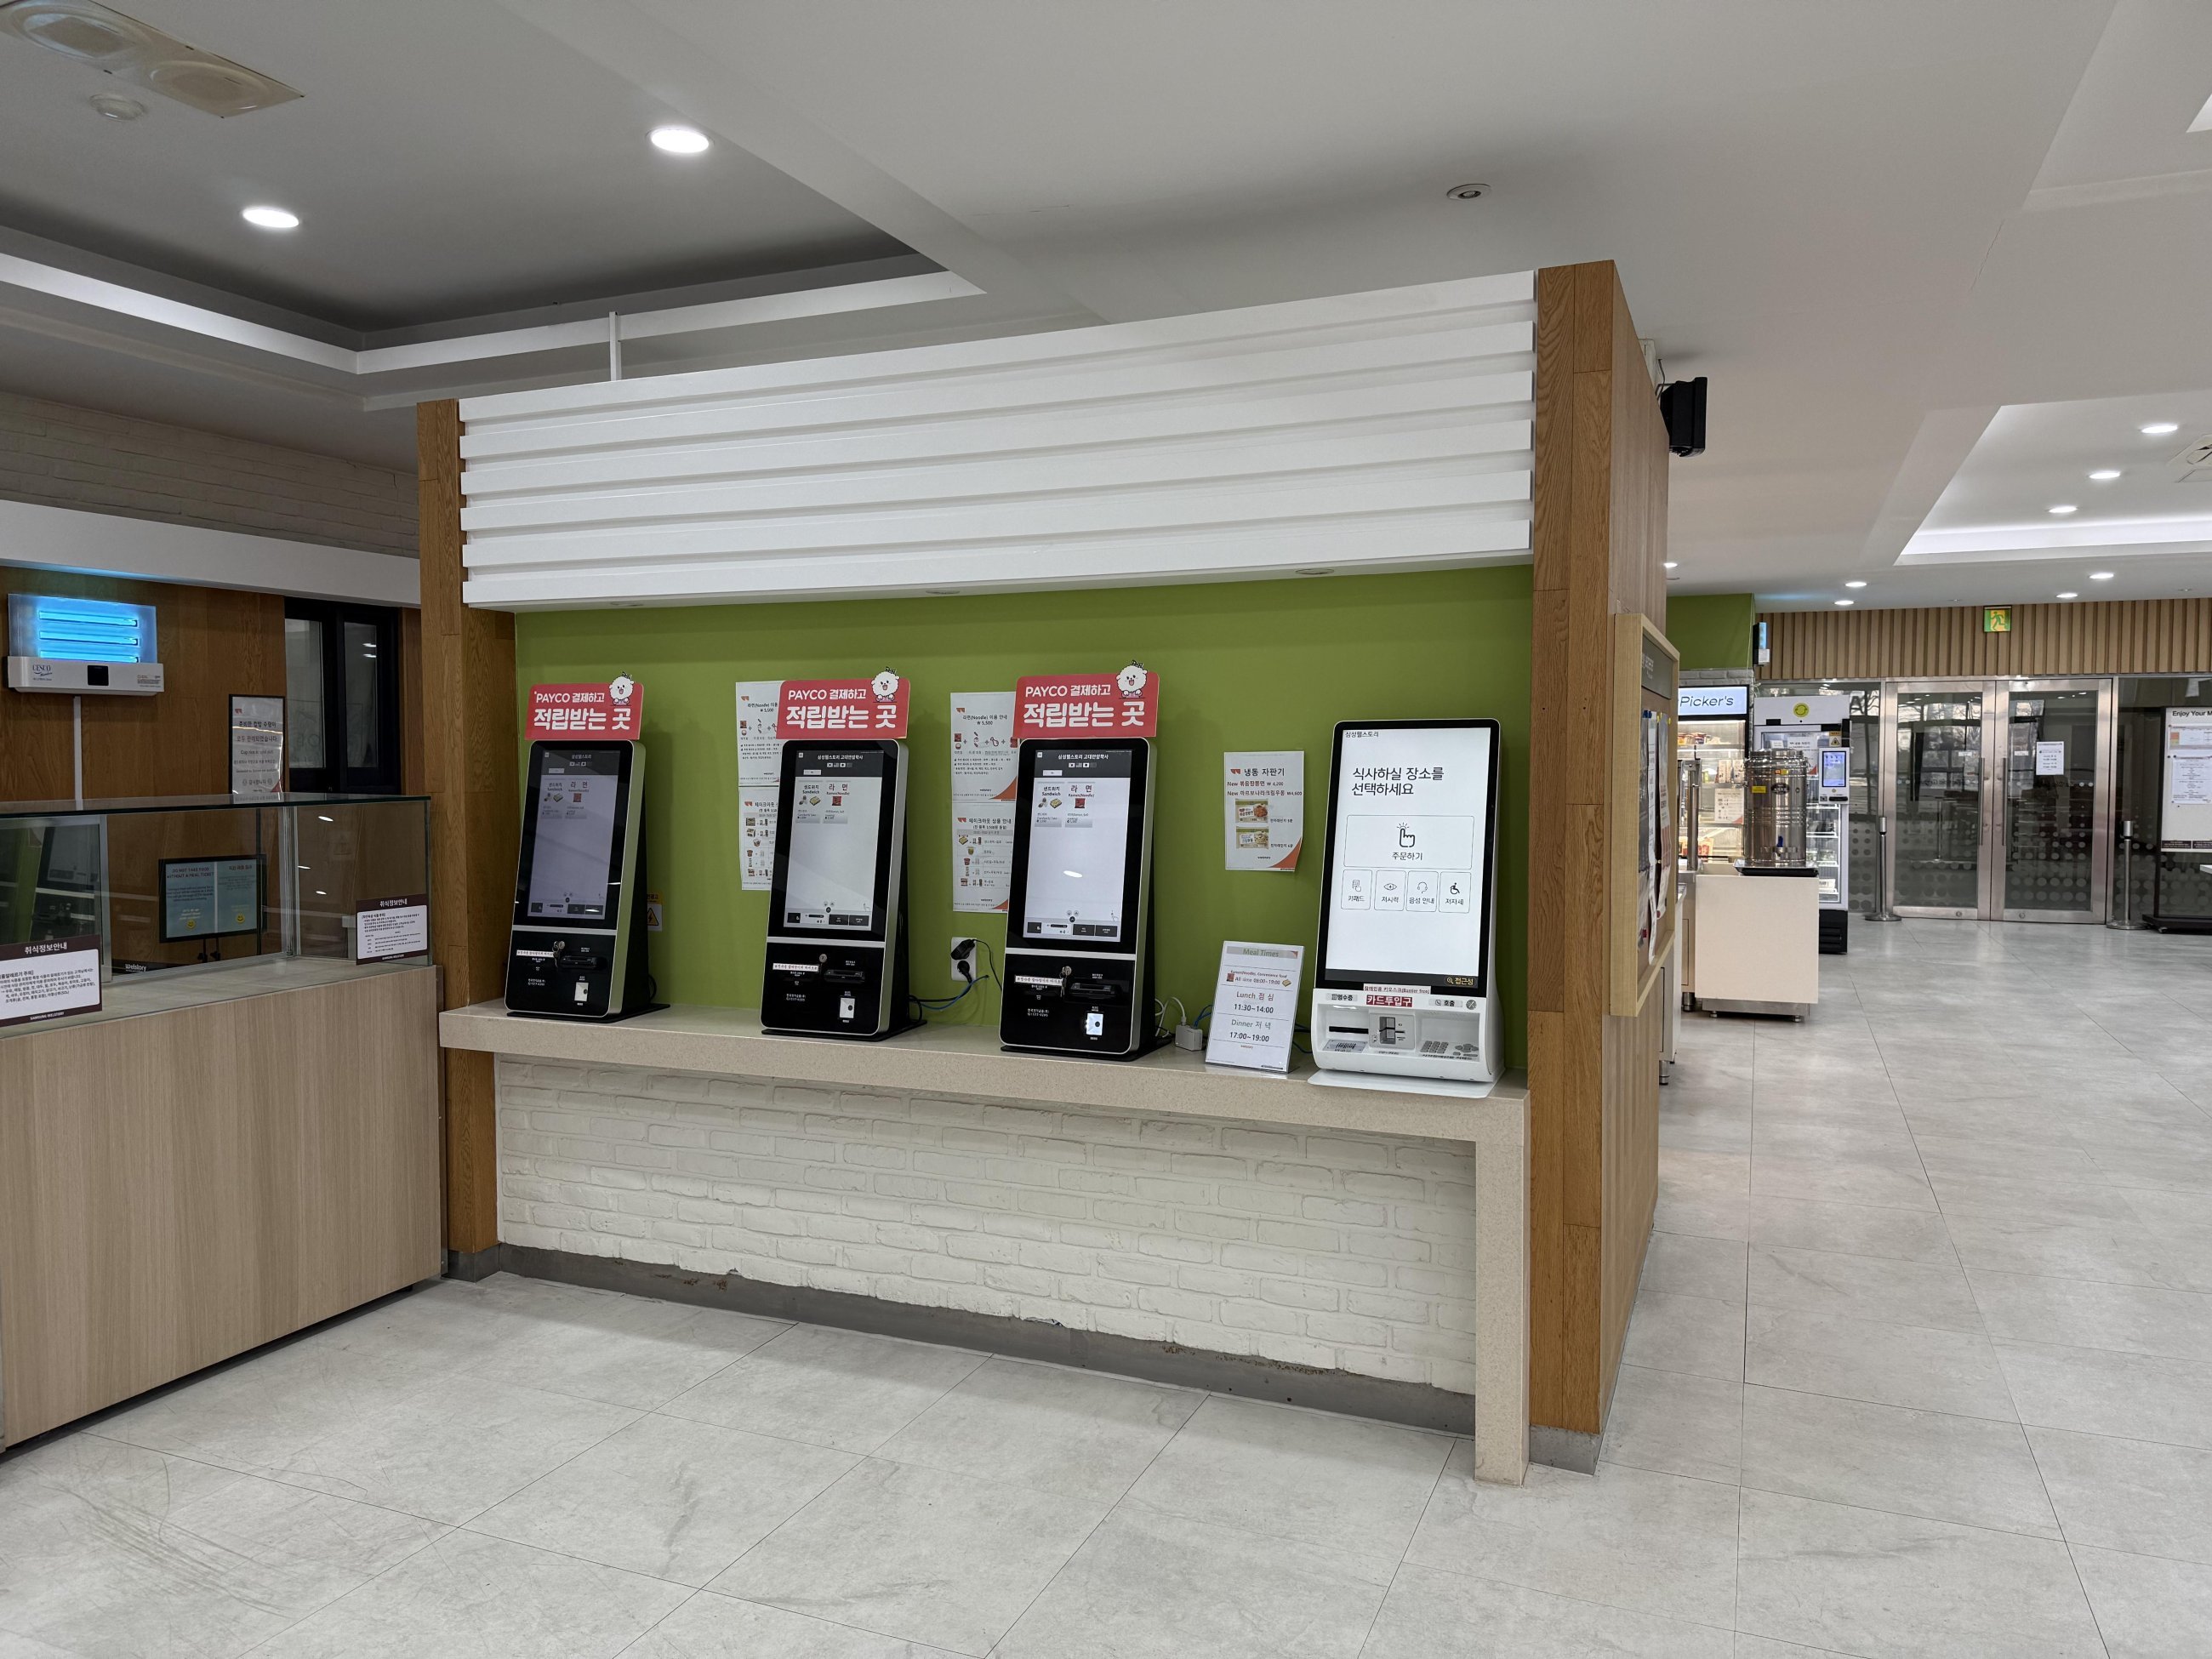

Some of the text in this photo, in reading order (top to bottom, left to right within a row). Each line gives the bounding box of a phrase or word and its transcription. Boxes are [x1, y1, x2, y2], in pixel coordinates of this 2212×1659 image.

[788, 689, 866, 700] PAYCO 결제하고
[1025, 684, 1111, 697] PAYCO 결제하고
[536, 693, 605, 703] PAYCO 결제하고
[1679, 696, 1734, 707] Picker's
[534, 708, 630, 730] 적립받는 곳
[786, 704, 897, 729] 적립받는 곳
[1023, 701, 1145, 727] 적립받는 곳
[1352, 767, 1445, 781] 식사하실 장소를
[1351, 783, 1415, 796] 선택하세요
[1391, 852, 1423, 861] 주문하기
[25, 942, 67, 954] 취식정보안내
[1236, 991, 1256, 1000] Lunch
[1258, 992, 1265, 1001] 점
[1366, 995, 1412, 1007] 카드투입구
[1234, 1003, 1274, 1013] 11:30~14:00
[1231, 1019, 1253, 1028] Dinner
[1255, 1021, 1262, 1029] 저
[1229, 1032, 1269, 1042] 17:00~19:00
